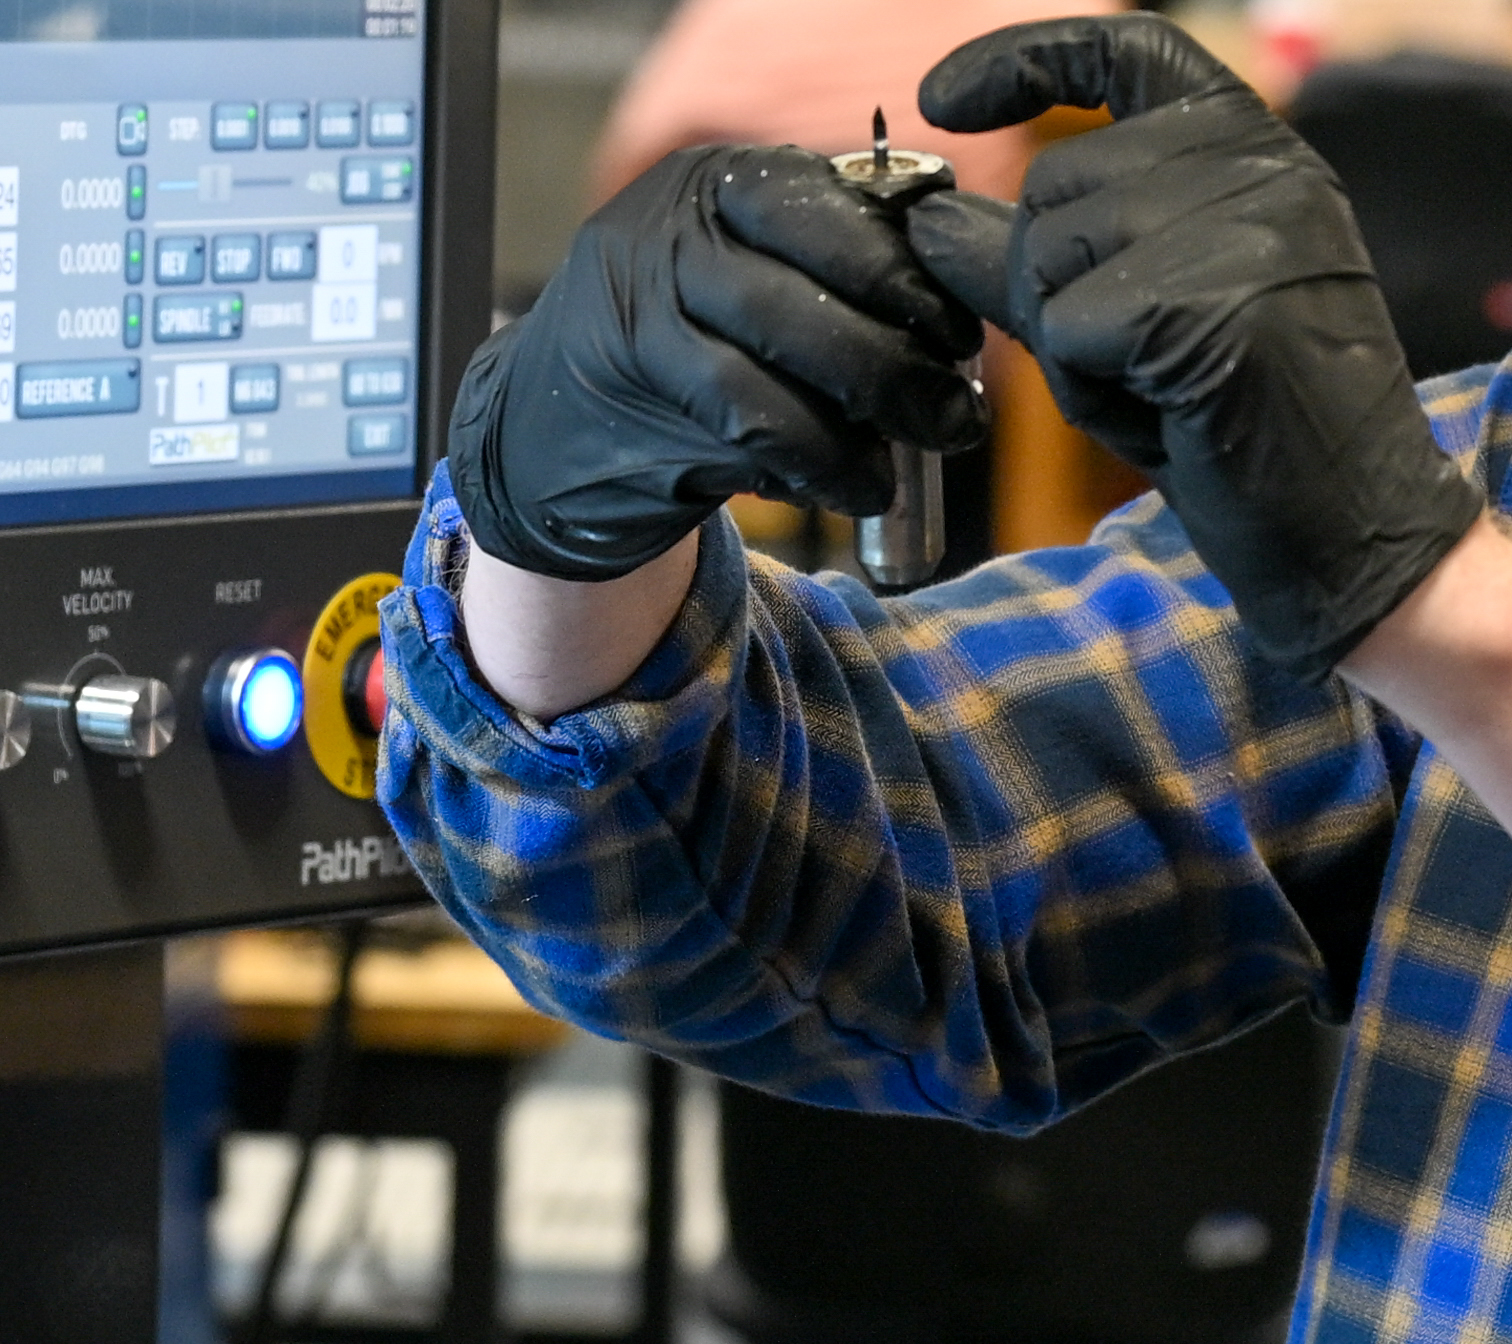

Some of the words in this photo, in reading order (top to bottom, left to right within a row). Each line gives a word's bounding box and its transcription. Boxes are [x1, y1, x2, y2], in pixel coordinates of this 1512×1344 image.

[60, 177, 123, 210] 0.0000
[59, 242, 122, 275] 0.0000
[57, 306, 120, 340] 0.0000
[99, 375, 111, 402] A
[62, 589, 134, 616] VELOCITY
[215, 579, 263, 604] RESET
